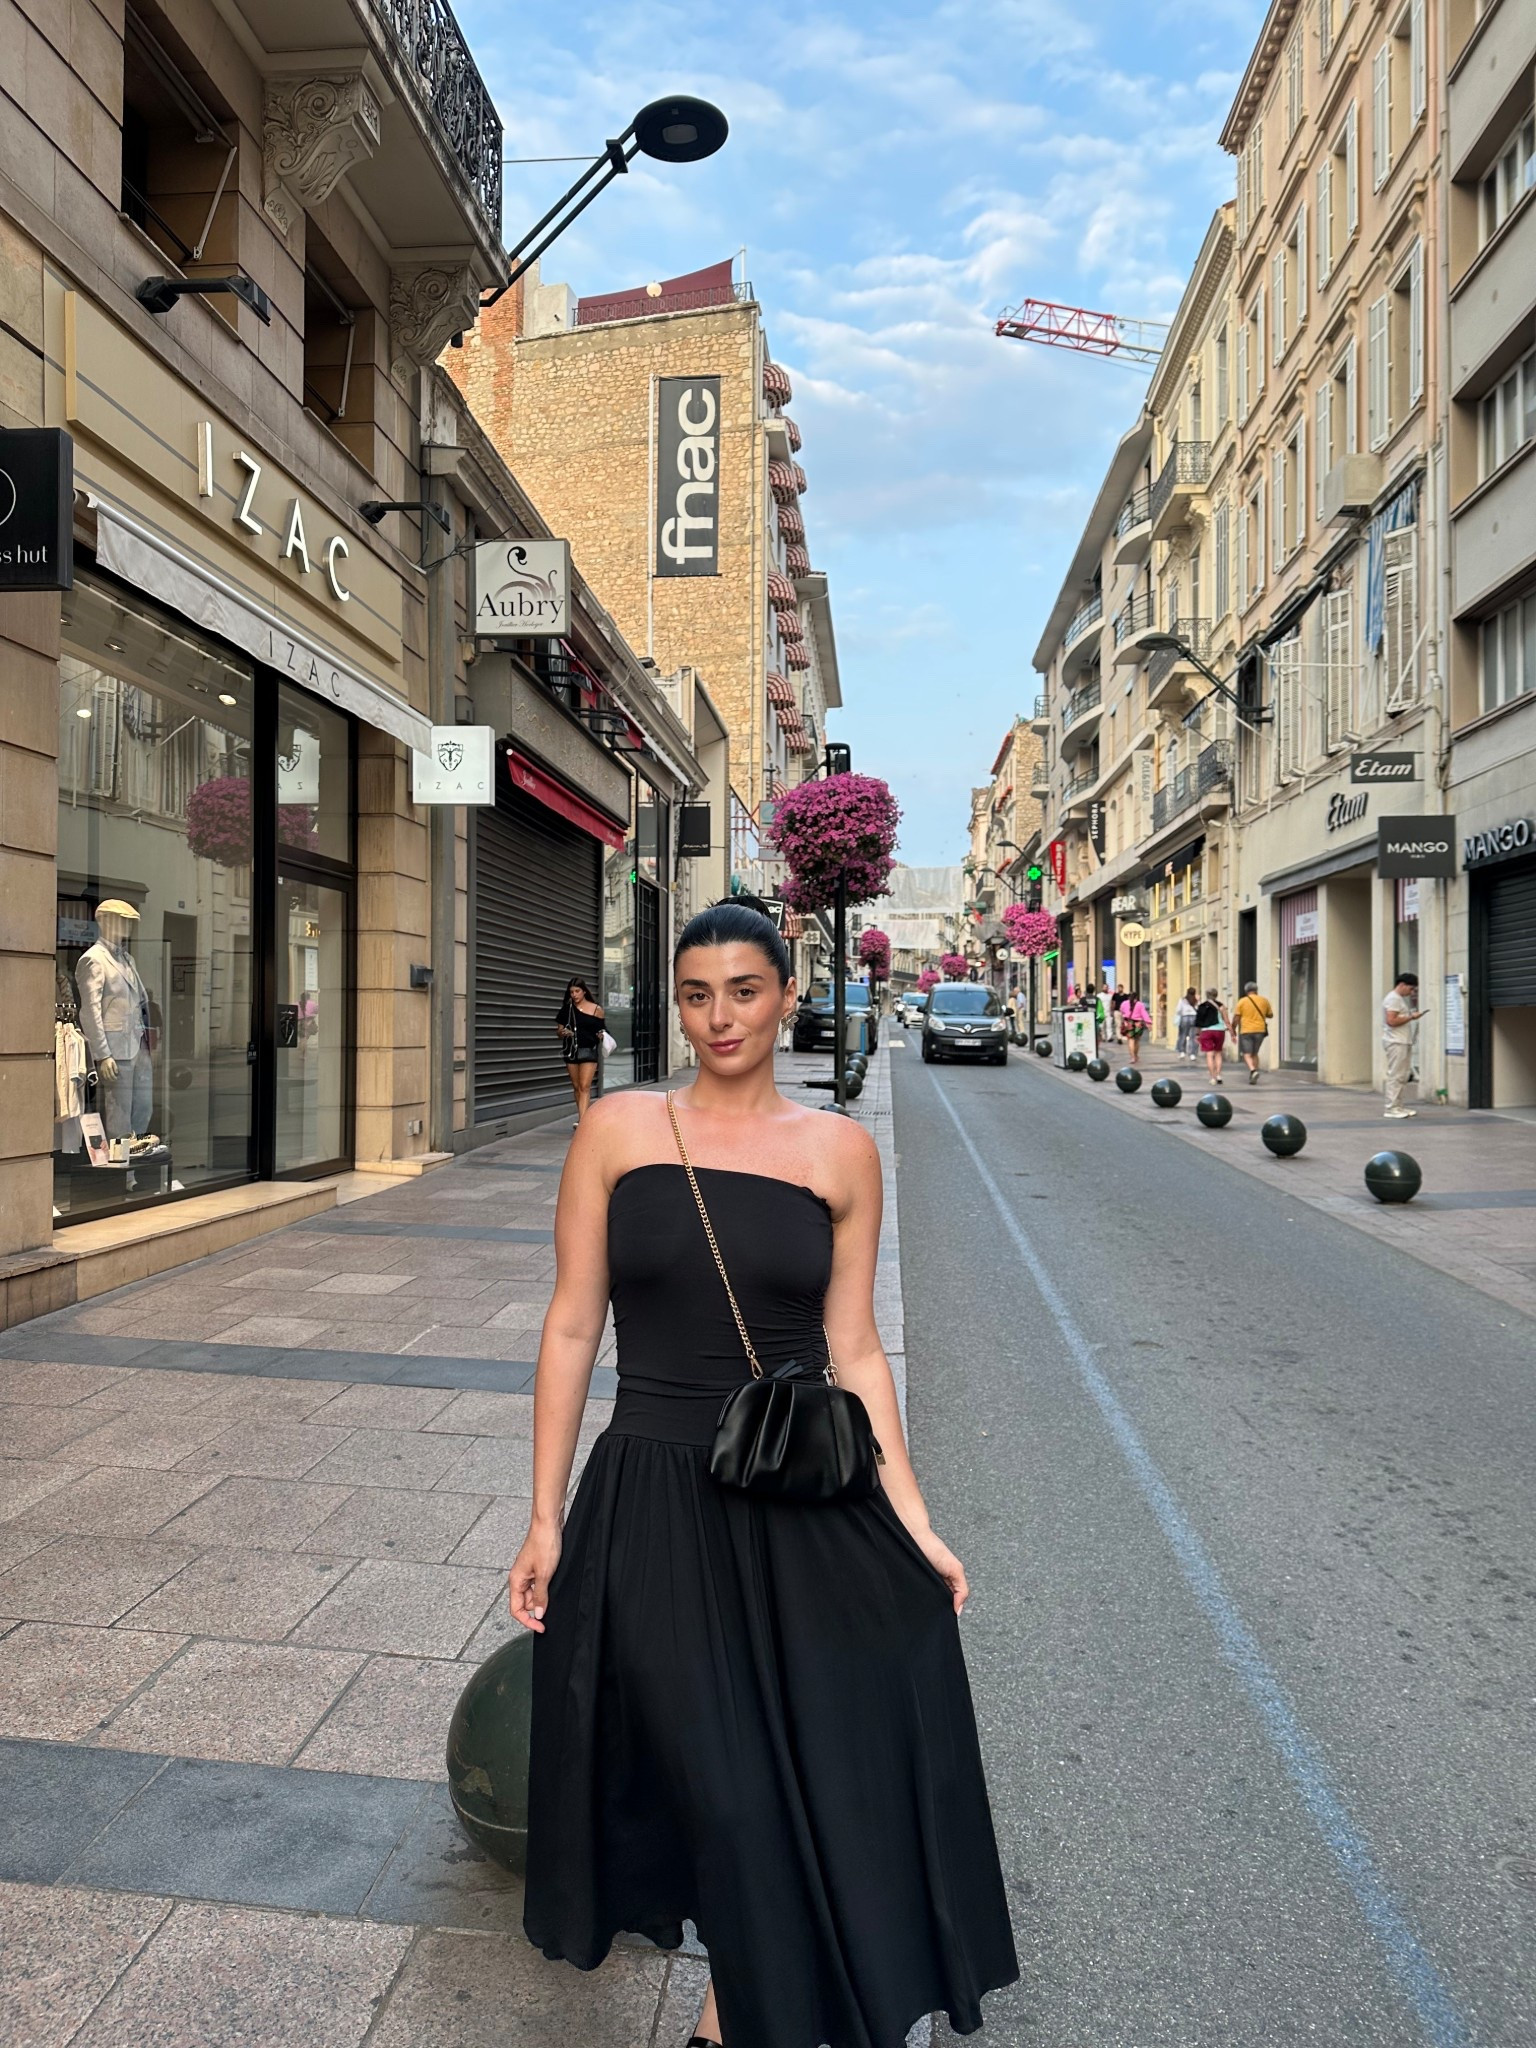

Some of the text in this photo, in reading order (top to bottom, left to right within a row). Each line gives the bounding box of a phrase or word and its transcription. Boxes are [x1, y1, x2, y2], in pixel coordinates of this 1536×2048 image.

[661, 388, 716, 565] fnac
[198, 421, 350, 602] IZAC
[17, 544, 49, 564] hut
[476, 592, 564, 624] Aubry
[269, 630, 340, 698] IZAC
[418, 781, 484, 790] IZAC
[1354, 758, 1412, 777] Etam
[1091, 803, 1099, 840] SEPHORA
[1326, 792, 1369, 832] Etam
[1387, 841, 1449, 854] MANGO
[1463, 819, 1529, 862] MANGO
[1055, 843, 1063, 884] DARTY
[1123, 930, 1142, 939] HYPE
